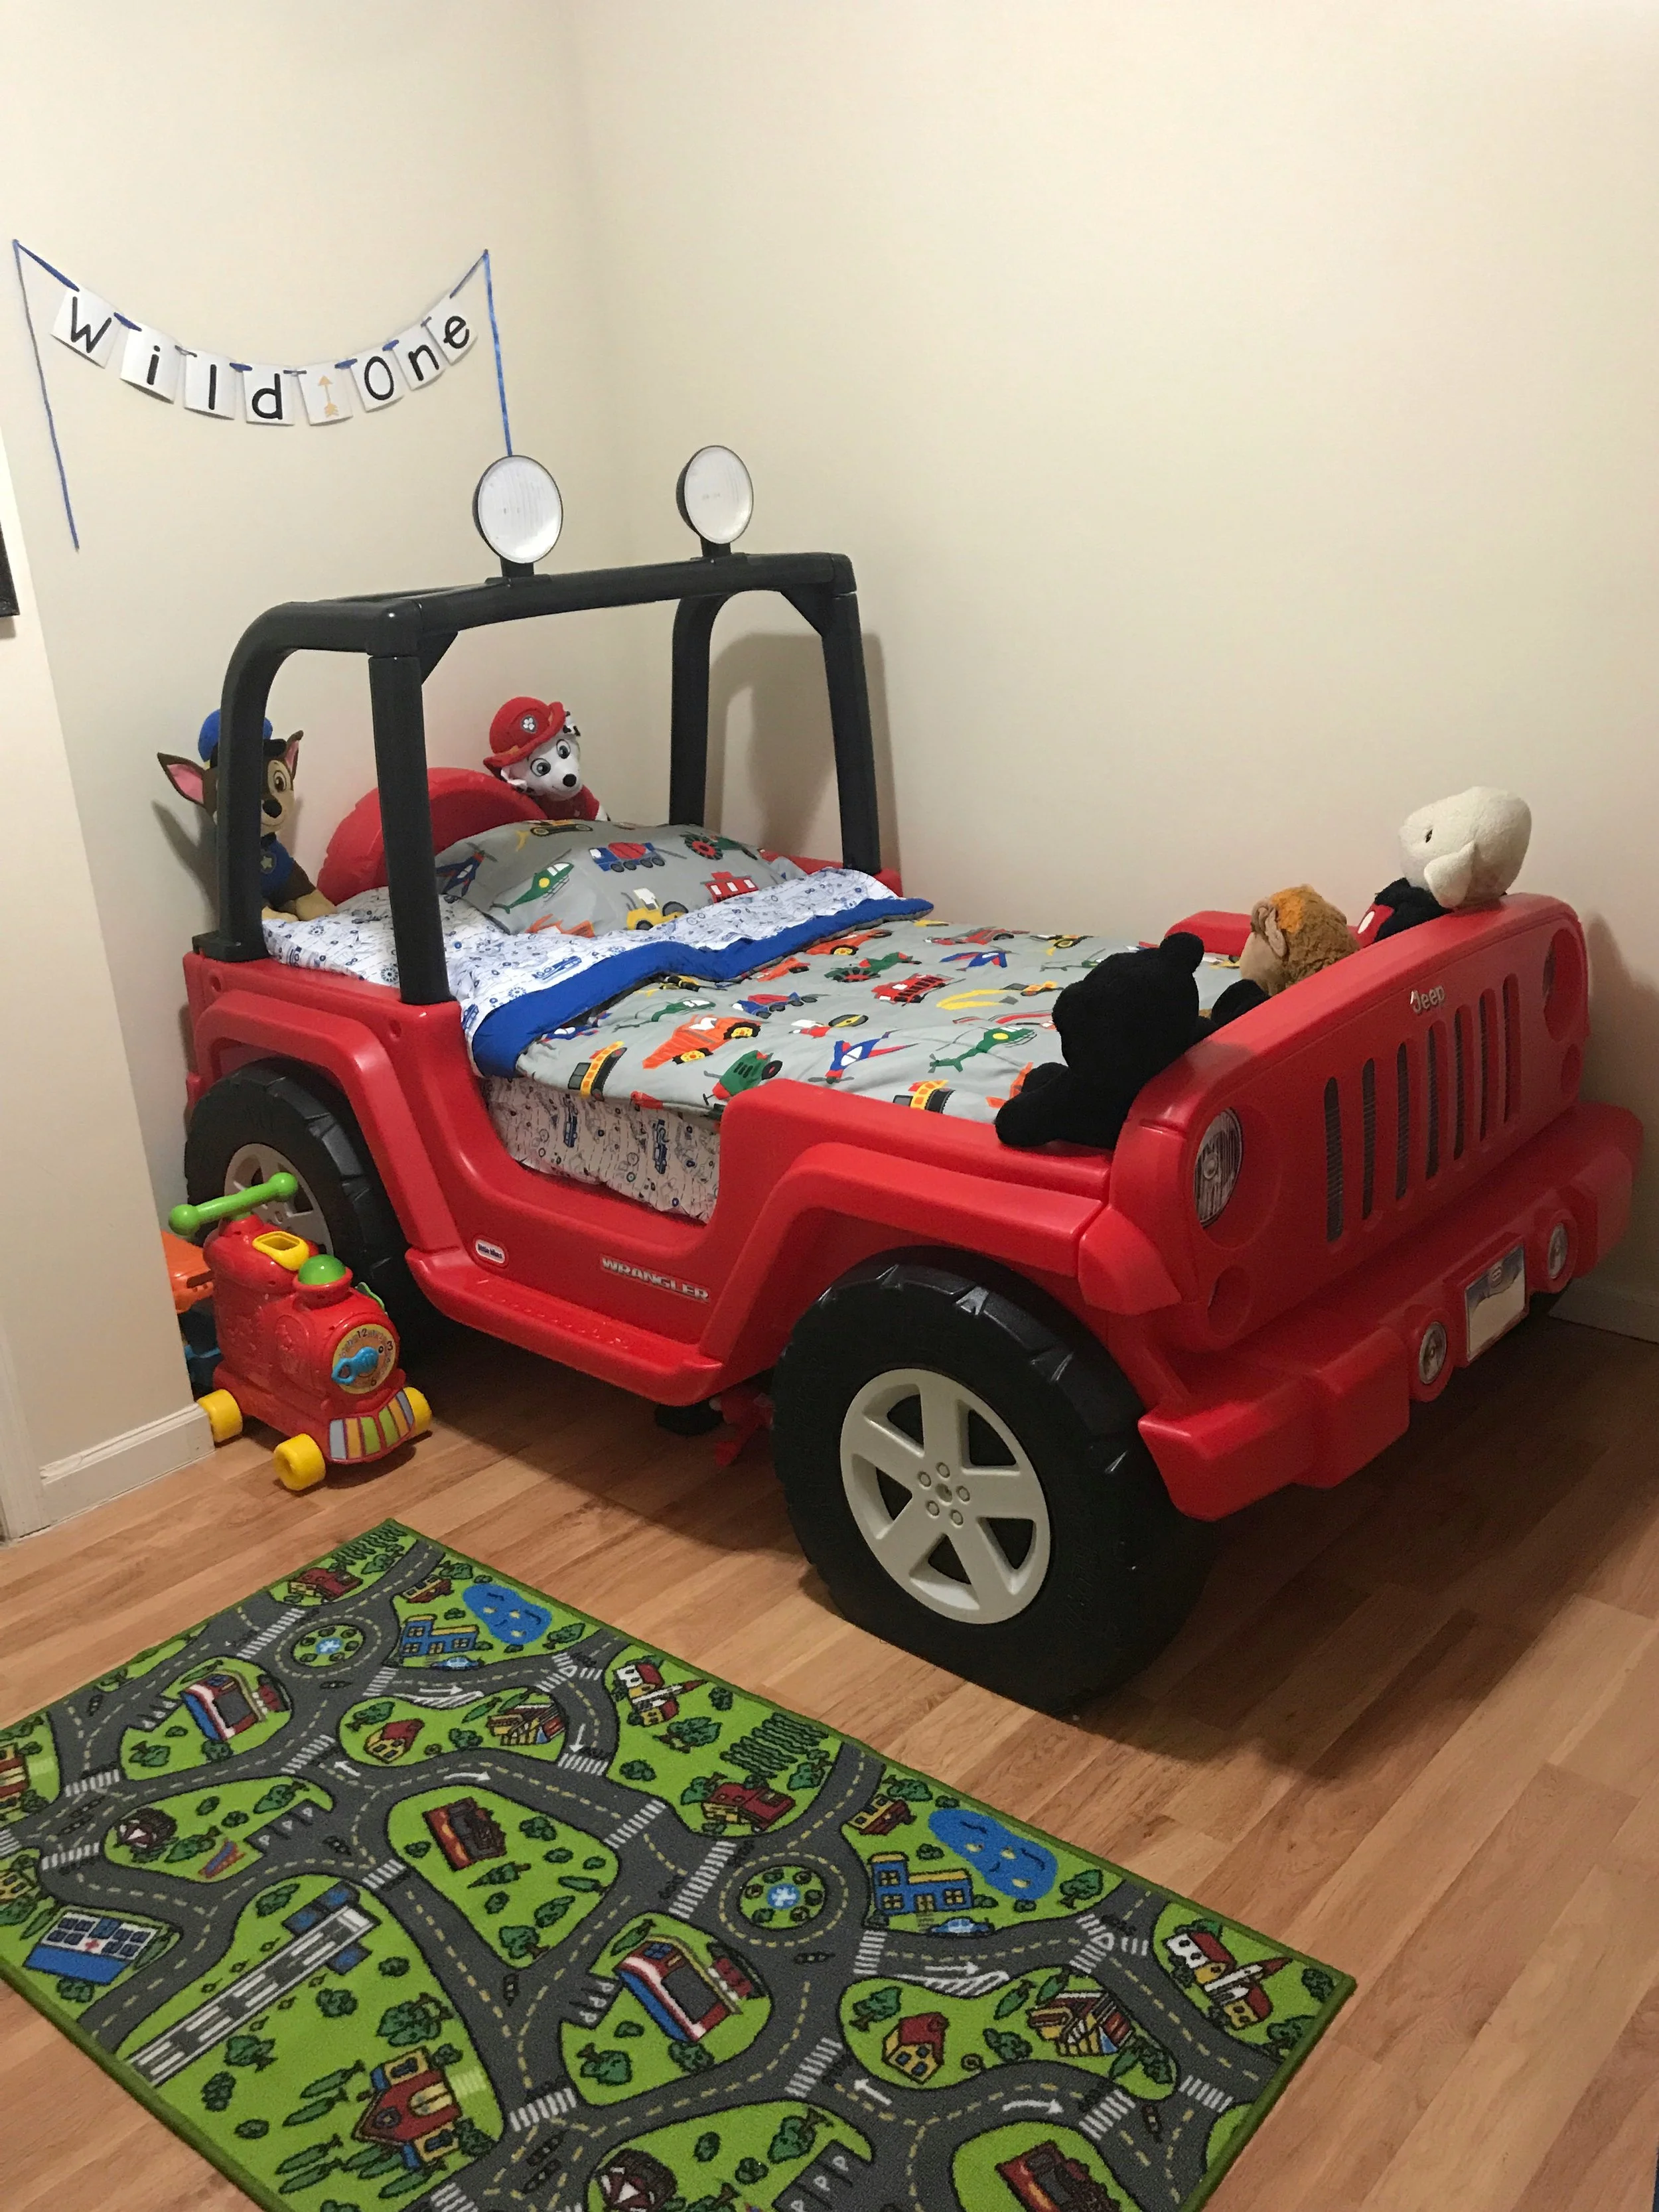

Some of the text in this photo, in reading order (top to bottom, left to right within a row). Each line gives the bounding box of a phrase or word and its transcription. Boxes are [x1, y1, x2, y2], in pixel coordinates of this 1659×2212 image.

[70, 296, 470, 419] Wild One
[1409, 985, 1445, 1013] Jeep
[601, 1257, 709, 1300] WRANGLER
[356, 1327, 367, 1339] 12
[386, 1340, 394, 1351] 3
